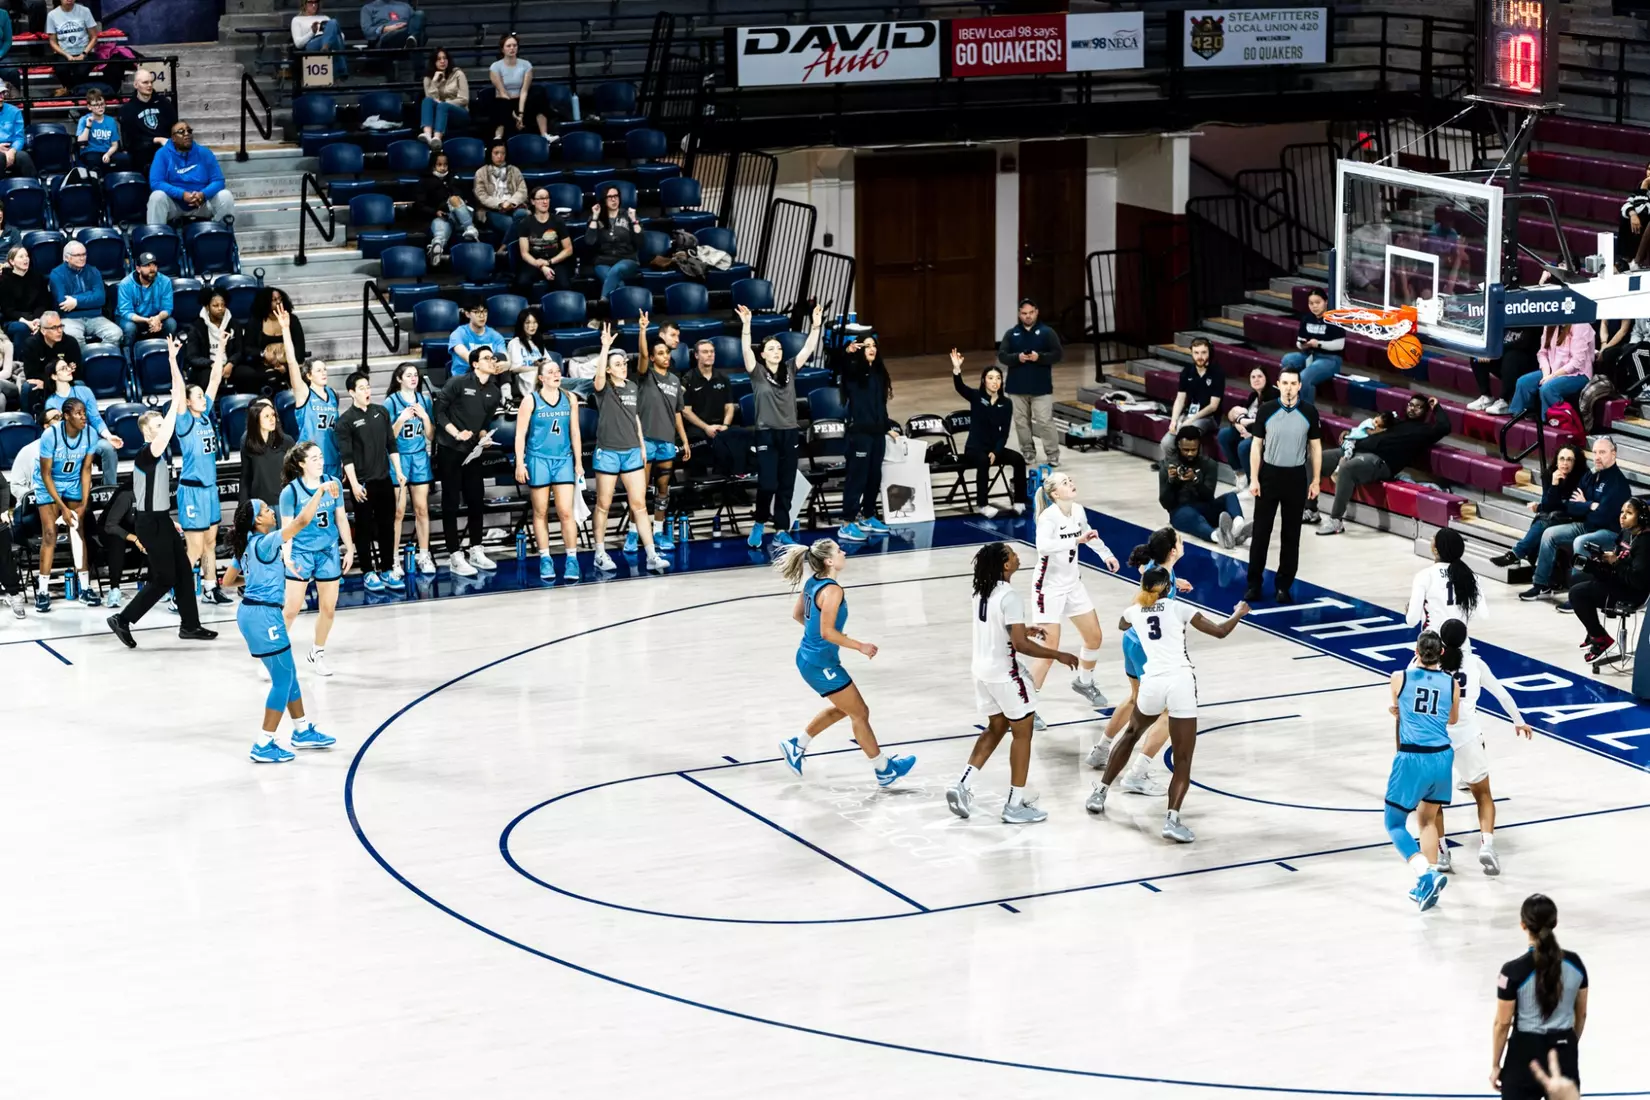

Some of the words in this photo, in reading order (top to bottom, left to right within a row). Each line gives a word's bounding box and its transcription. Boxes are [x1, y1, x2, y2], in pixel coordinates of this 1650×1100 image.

[1228, 11, 1319, 22] STEAMFITTERS
[959, 28, 988, 40] IBEW
[989, 27, 1016, 39] Local
[1018, 26, 1032, 37] 98
[1033, 26, 1058, 38] says:
[1228, 23, 1262, 33] LOCAL
[1265, 22, 1298, 32] UNION
[1300, 22, 1319, 31] 420
[744, 21, 937, 55] DAVID
[1092, 37, 1106, 49] 98
[1107, 37, 1138, 49] NECA
[956, 42, 978, 66] GO
[982, 39, 1062, 65] QUAKERS!
[1243, 47, 1257, 60] GO
[1259, 46, 1303, 60] QUAKERS
[802, 42, 890, 82] Auto
[1509, 34, 1536, 89] 10
[150, 71, 165, 82] 04
[306, 64, 329, 75] 105
[1467, 298, 1559, 317] Inendence
[317, 413, 335, 430] 34
[551, 419, 561, 436] 4
[813, 423, 845, 434] PENN
[910, 419, 943, 431] PENN
[951, 416, 971, 427] PEN
[62, 461, 75, 473] 0
[186, 505, 196, 518] C
[316, 510, 329, 528] 3
[267, 625, 280, 640] C
[1146, 615, 1162, 640] 3
[822, 667, 837, 680] C
[1413, 687, 1440, 716] 21
